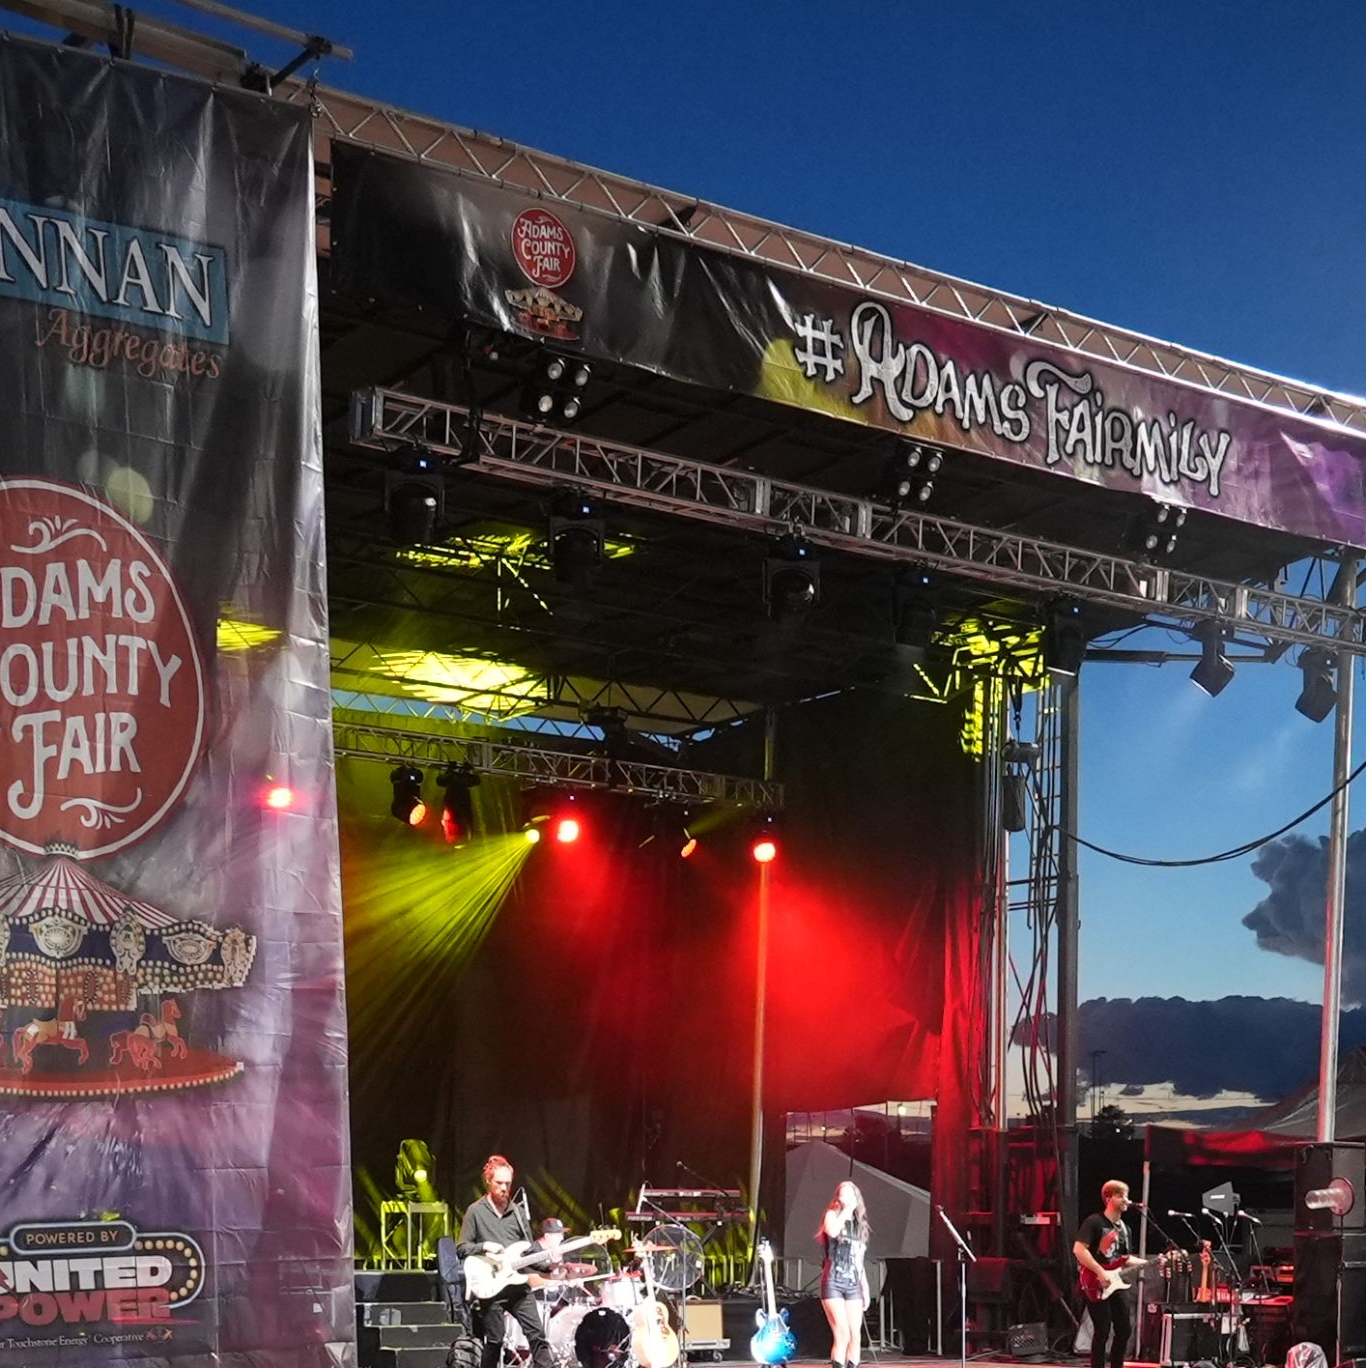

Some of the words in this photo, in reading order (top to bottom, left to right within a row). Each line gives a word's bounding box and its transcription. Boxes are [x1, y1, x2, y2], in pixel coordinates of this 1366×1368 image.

[517, 217, 564, 241] ADAMS
[521, 238, 571, 260] COUNTY
[531, 255, 561, 279] FAIR
[34, 308, 224, 379] Aggregates
[6, 709, 142, 820] FAIR
[26, 1232, 95, 1245] POWERED
[100, 1230, 120, 1242] BY
